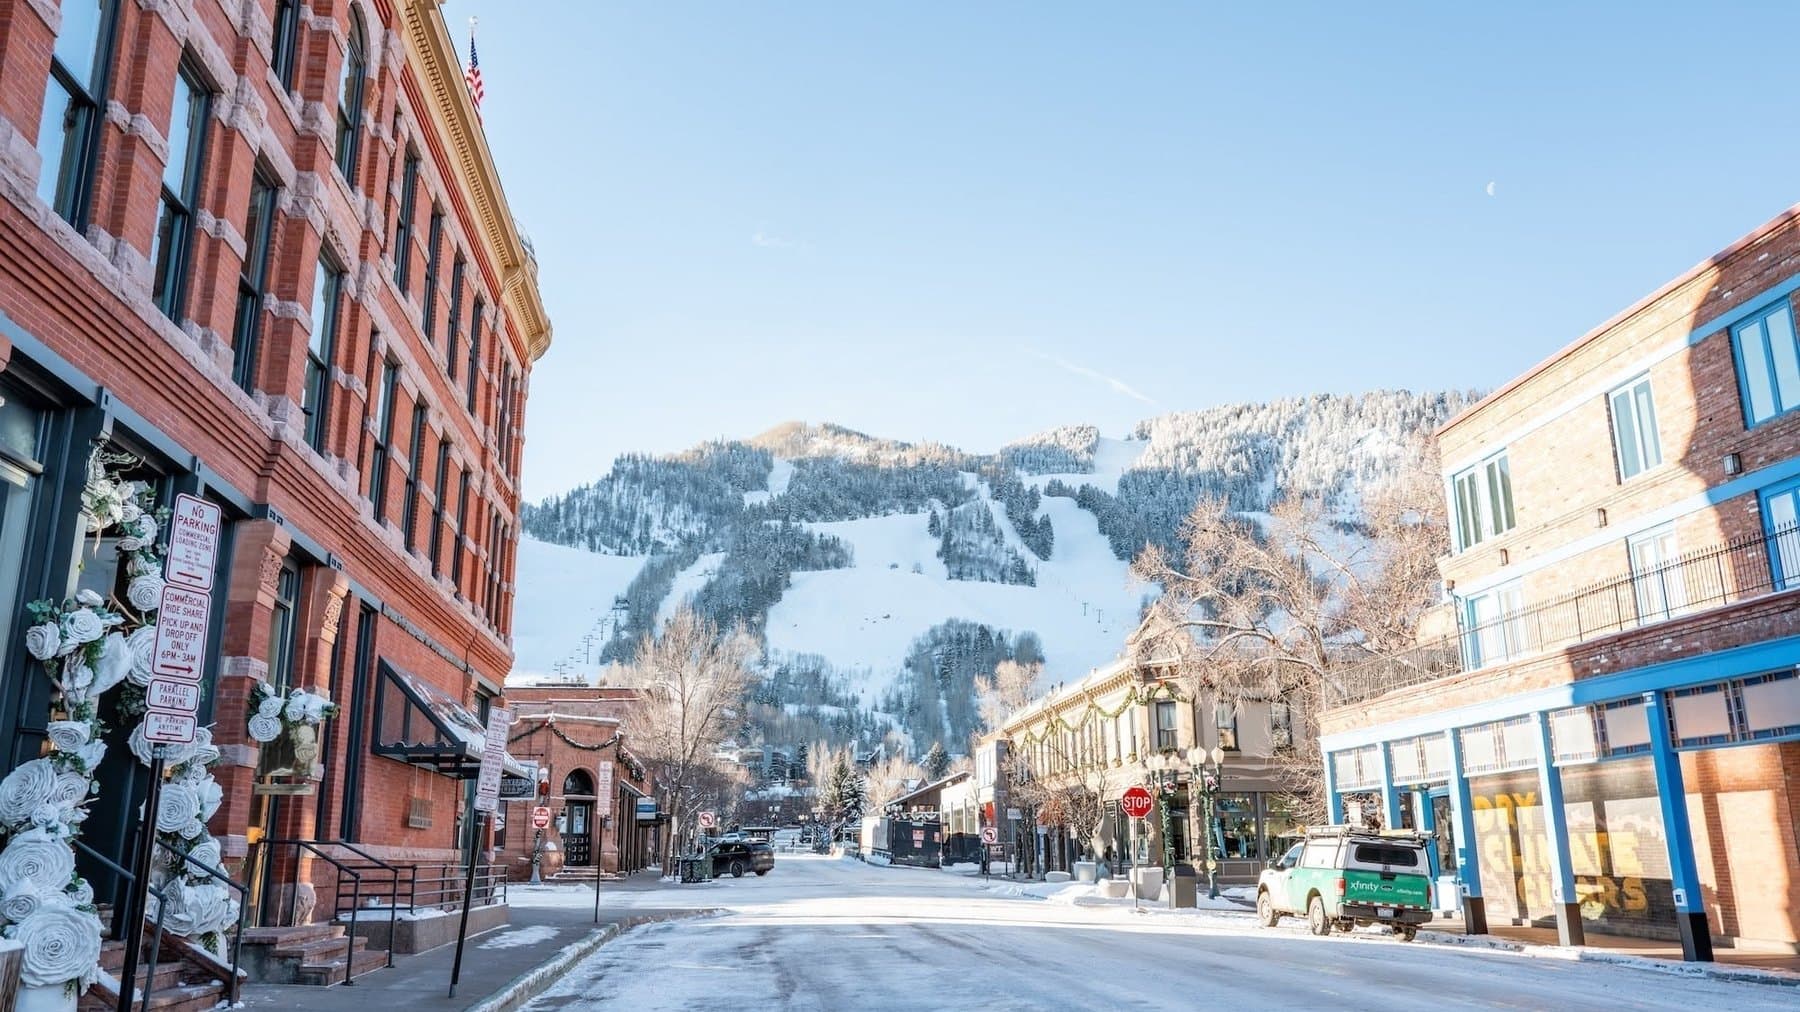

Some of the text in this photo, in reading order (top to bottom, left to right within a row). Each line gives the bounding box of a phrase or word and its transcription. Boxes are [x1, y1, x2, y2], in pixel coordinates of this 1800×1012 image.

[192, 506, 204, 519] NO
[177, 515, 216, 535] PARKING
[178, 528, 212, 545] COMMERCIAL
[175, 535, 212, 553] LOADING ZONE
[165, 592, 206, 609] COMMERCIAL
[165, 603, 206, 619] RIDE SHARE
[161, 616, 204, 633] PICK UP AND
[165, 628, 199, 641] DROP OFF
[171, 640, 190, 651] ONLY
[161, 650, 177, 660] 6PM
[182, 653, 196, 663] 3AM
[160, 683, 190, 697] PARALLEL
[160, 694, 187, 707] PARKING
[1124, 796, 1151, 809] STOP
[1474, 791, 1537, 832] DRY
[1350, 881, 1380, 893] xfinity
